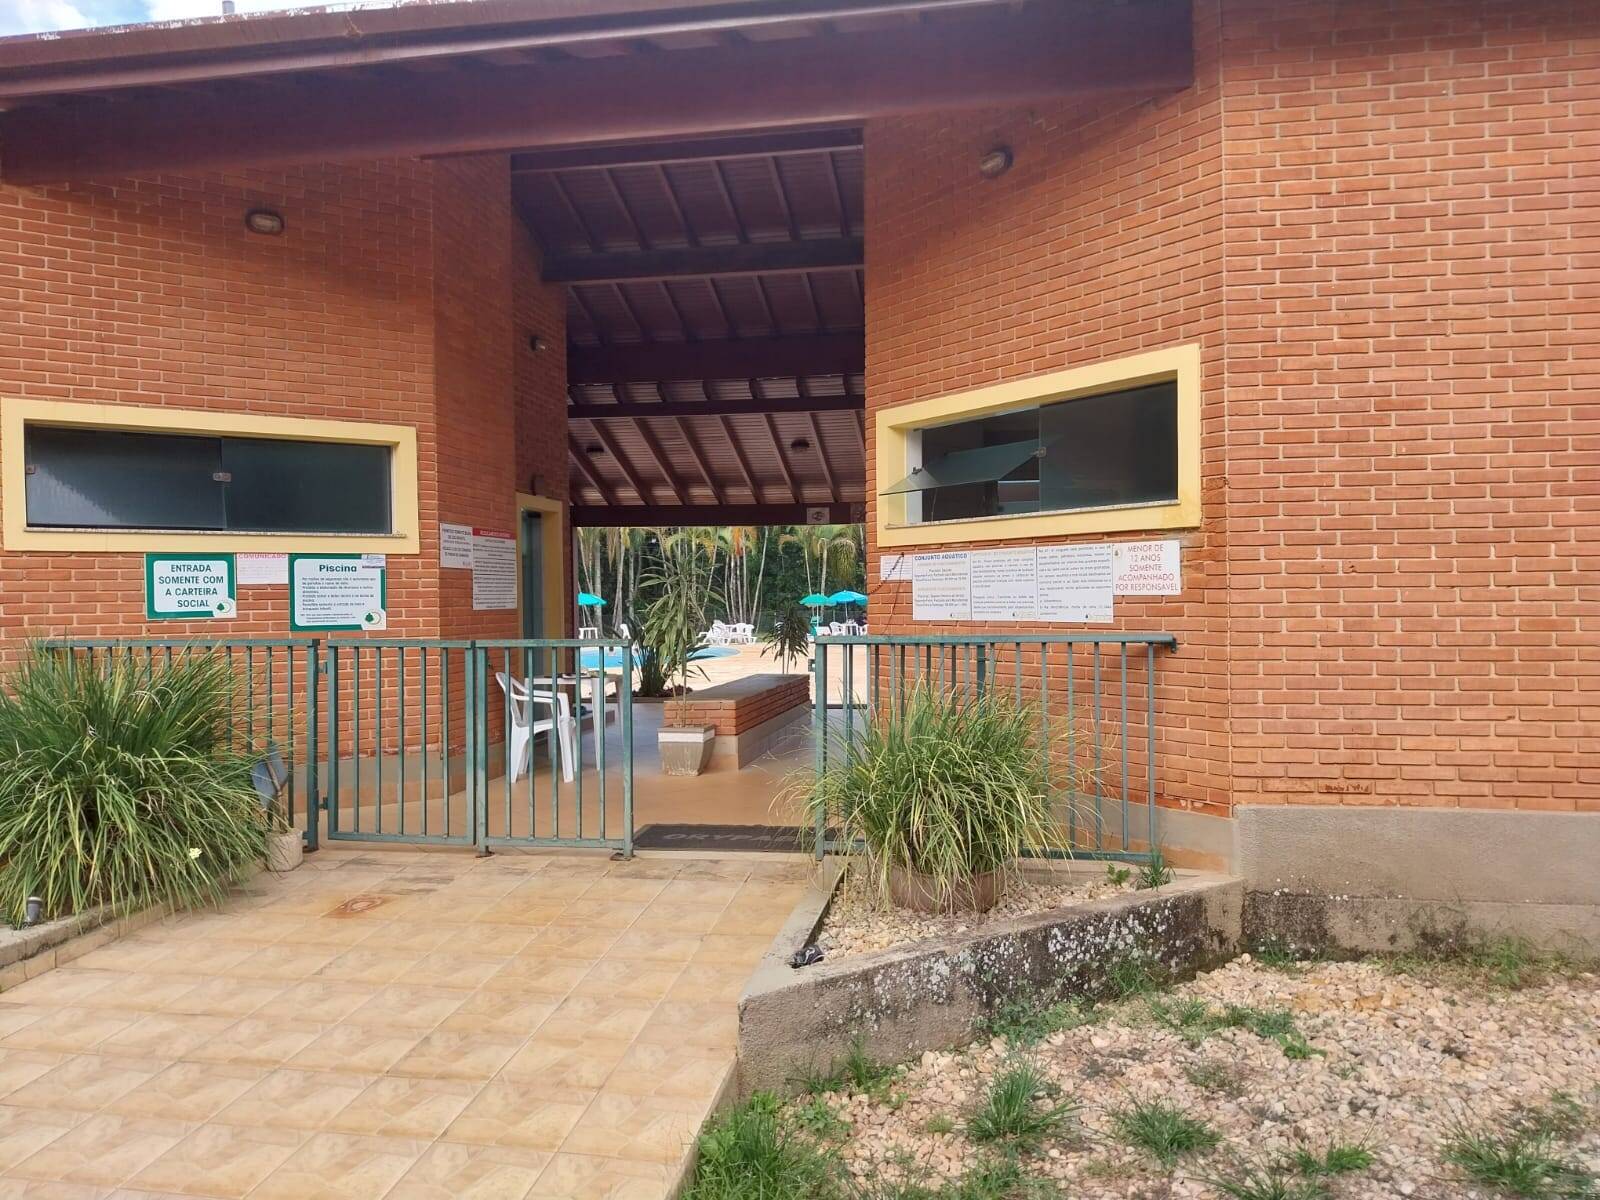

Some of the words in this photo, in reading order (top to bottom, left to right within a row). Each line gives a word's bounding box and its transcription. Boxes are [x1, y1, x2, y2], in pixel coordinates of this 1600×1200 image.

[1127, 543, 1152, 552] MENOR
[1154, 543, 1164, 552] DE
[1140, 553, 1161, 562] ANOS
[170, 564, 212, 573] ENTRADA
[319, 564, 357, 573] Piscina
[1129, 563, 1162, 572] SOMENTE
[158, 575, 200, 585] SOMENTE
[202, 575, 224, 584] COM
[1118, 573, 1174, 582] ACOMPANHADO
[1115, 583, 1129, 591] POR
[165, 588, 172, 596] A
[175, 587, 218, 597] CARTEIRA
[177, 599, 209, 608] SOCIAL
